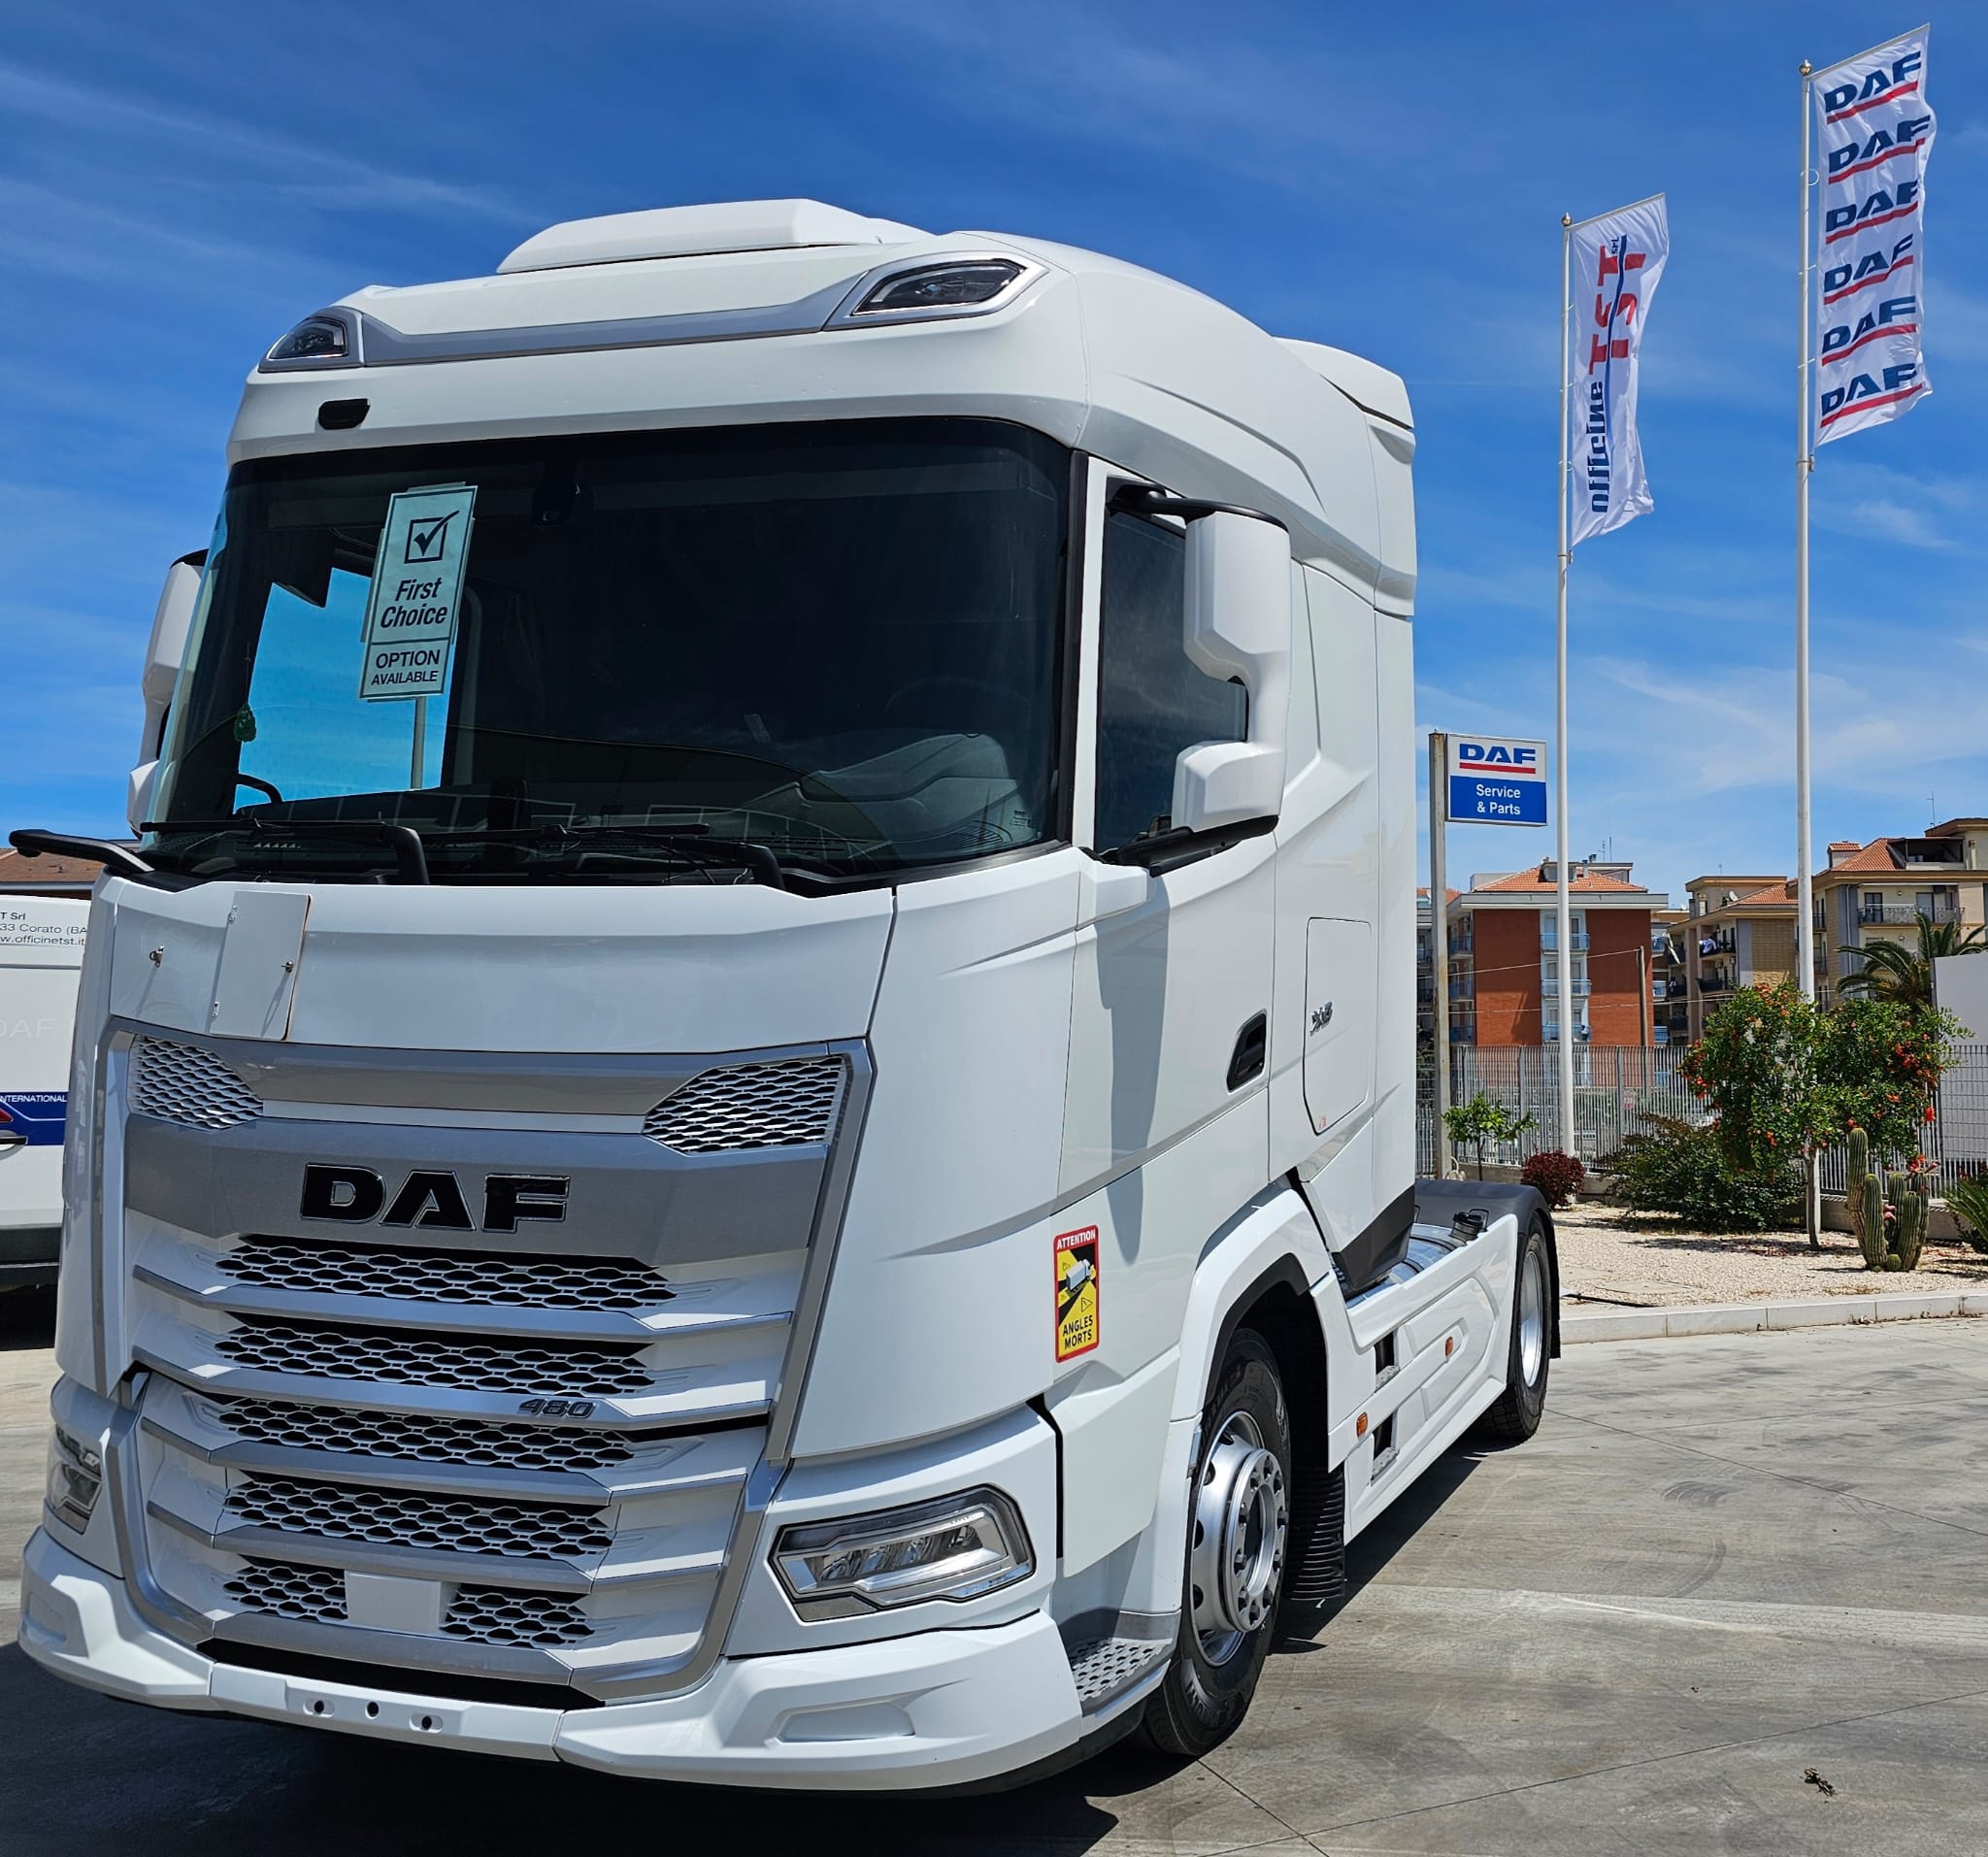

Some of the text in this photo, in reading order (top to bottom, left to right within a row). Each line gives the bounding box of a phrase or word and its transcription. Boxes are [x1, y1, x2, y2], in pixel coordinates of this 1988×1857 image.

[1824, 50, 1921, 113] DAF
[1828, 115, 1931, 173] DAF
[1826, 180, 1919, 232] DAF
[1824, 233, 1914, 292] DAF
[1589, 245, 1646, 375] TST
[1821, 295, 1916, 354] DAF
[1820, 363, 1917, 416] DAF
[1586, 381, 1609, 514] officine
[394, 577, 443, 602] First
[380, 603, 448, 628] Choice
[375, 648, 441, 669] OPTION
[371, 670, 439, 685] AVAILABLE
[1459, 743, 1536, 765] DAF
[1475, 783, 1521, 798] Service
[1476, 801, 1521, 815] & Parts
[10, 912, 26, 920] Srl
[19, 923, 62, 934] Corato
[300, 1162, 571, 1234] DAF
[1056, 1228, 1096, 1250] ATTENTION
[1062, 1314, 1094, 1336] ANGLES
[1064, 1329, 1092, 1350] MORTS
[517, 1398, 597, 1419] 480
